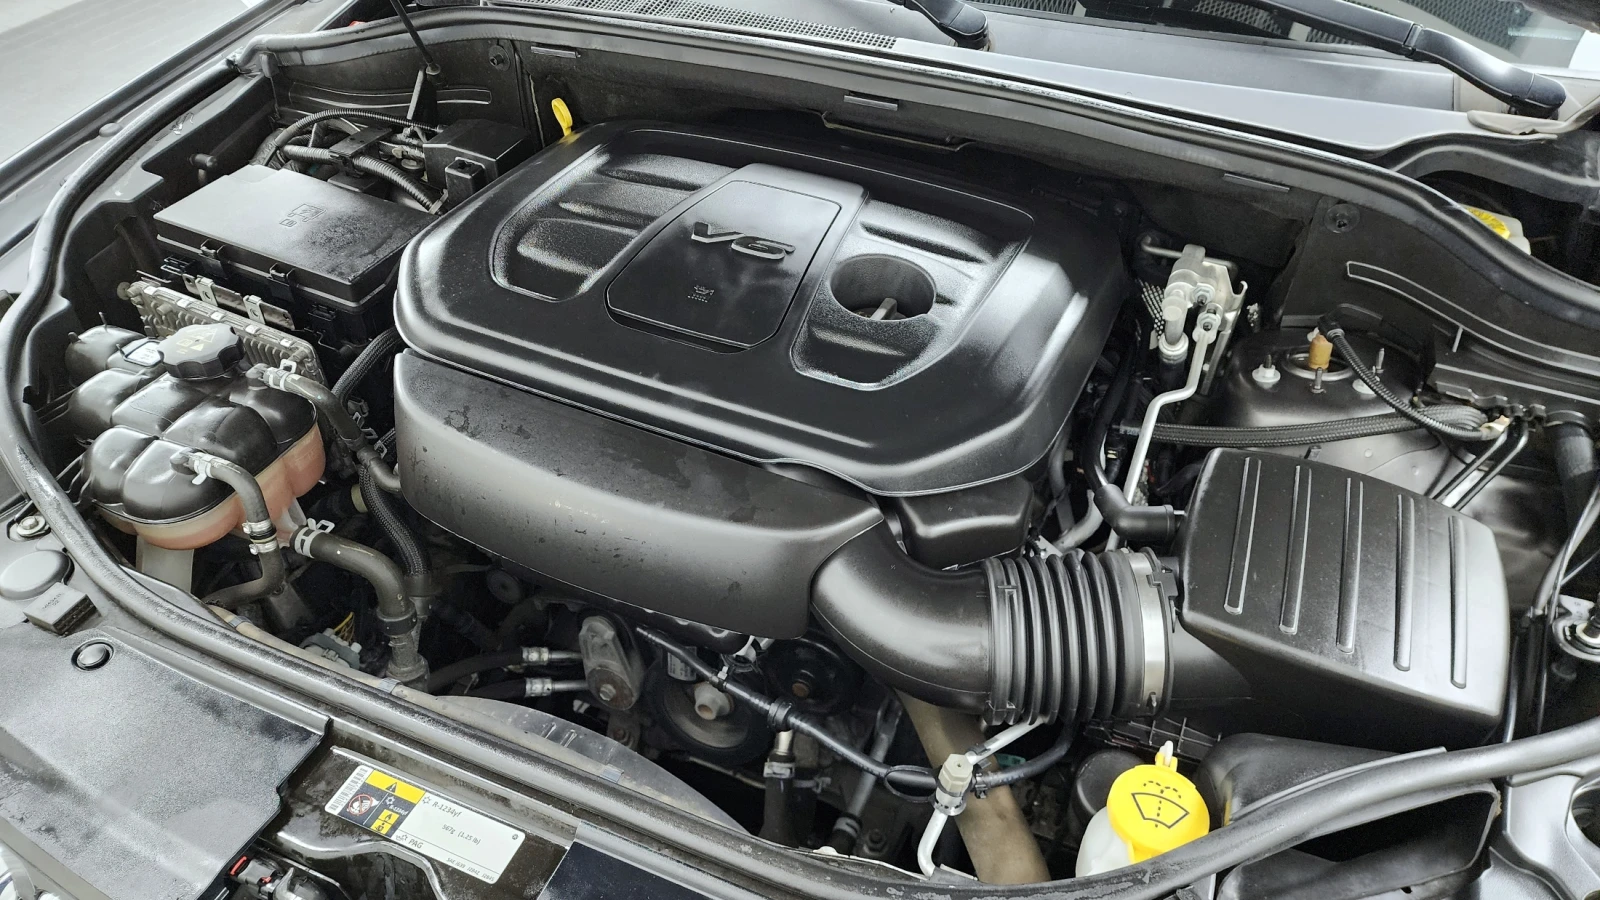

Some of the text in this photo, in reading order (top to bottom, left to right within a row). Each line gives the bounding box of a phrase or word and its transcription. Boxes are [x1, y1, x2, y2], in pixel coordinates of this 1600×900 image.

[690, 221, 797, 261] V6
[432, 801, 462, 817] R-1234yf
[441, 824, 482, 845] 567g (1.25 lb)
[408, 839, 423, 849] PAG
